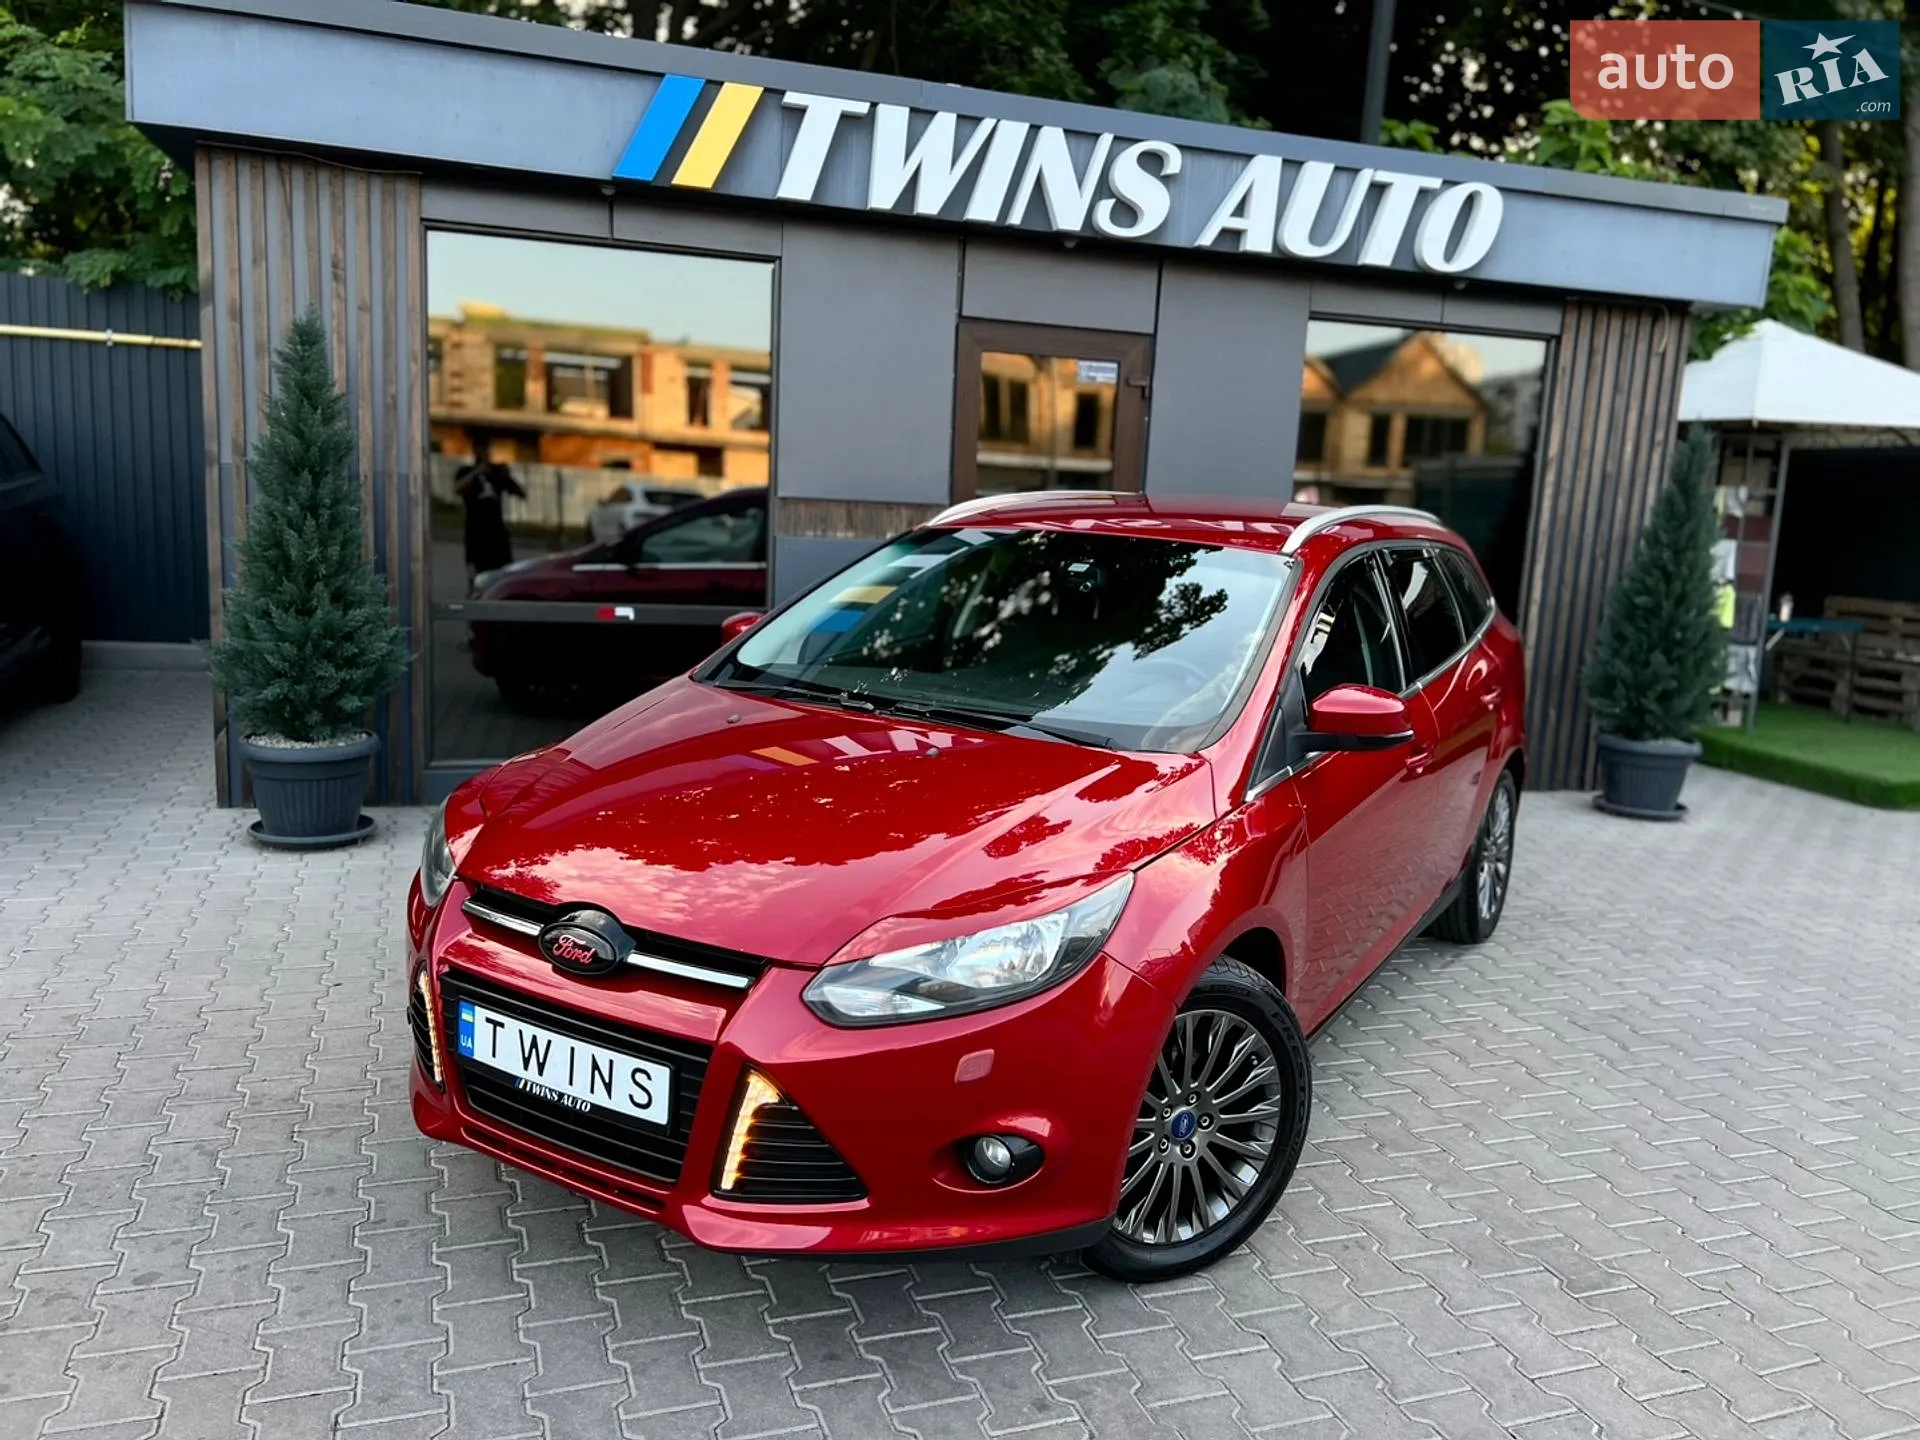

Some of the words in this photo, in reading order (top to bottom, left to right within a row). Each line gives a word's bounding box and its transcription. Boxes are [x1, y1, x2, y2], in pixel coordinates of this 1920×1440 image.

[776, 90, 1183, 238] TWINS
[1194, 154, 1504, 275] AUTO
[553, 934, 597, 966] Ford
[461, 1035, 474, 1050] UA
[485, 1018, 654, 1110] TWINS
[525, 1080, 559, 1101] TWINS
[560, 1094, 591, 1113] AUTO
